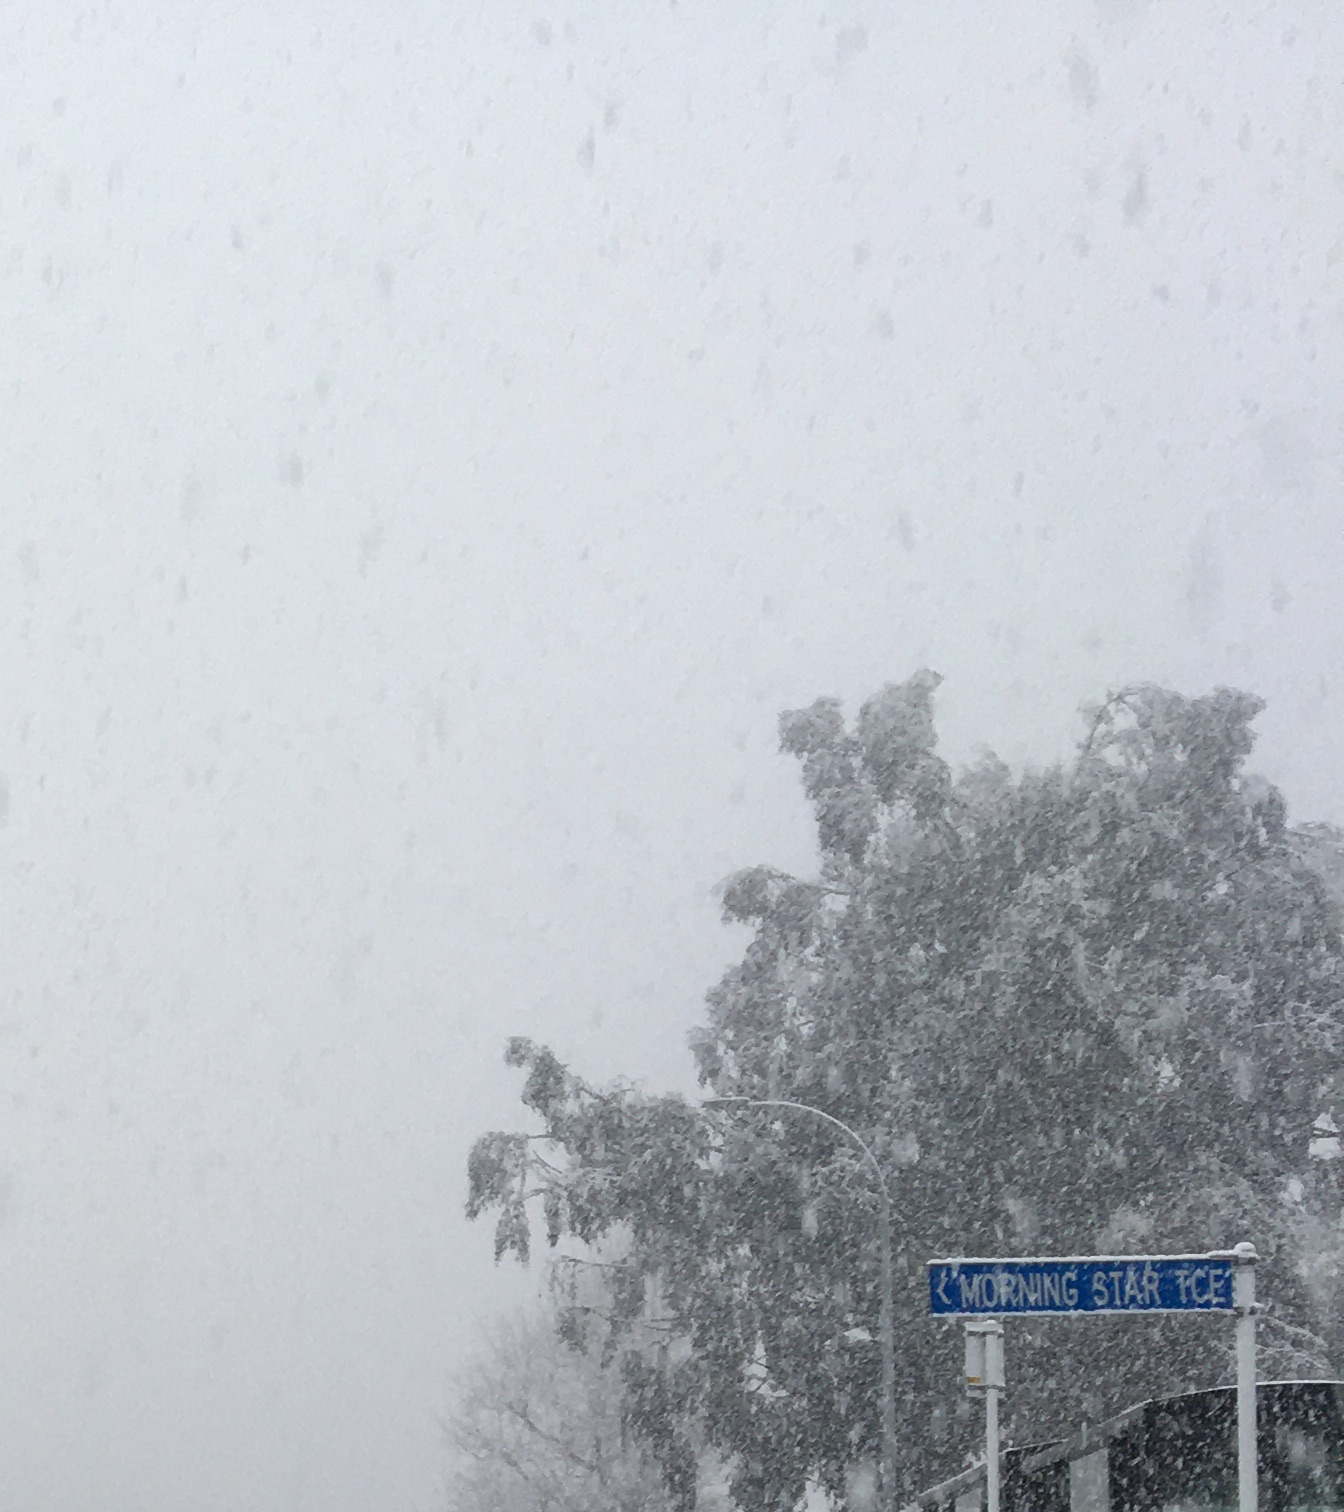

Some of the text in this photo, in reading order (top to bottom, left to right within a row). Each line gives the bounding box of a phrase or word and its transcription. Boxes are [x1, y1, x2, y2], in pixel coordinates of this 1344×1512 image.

[961, 1268, 1226, 1308] MORNING STAR TCE
